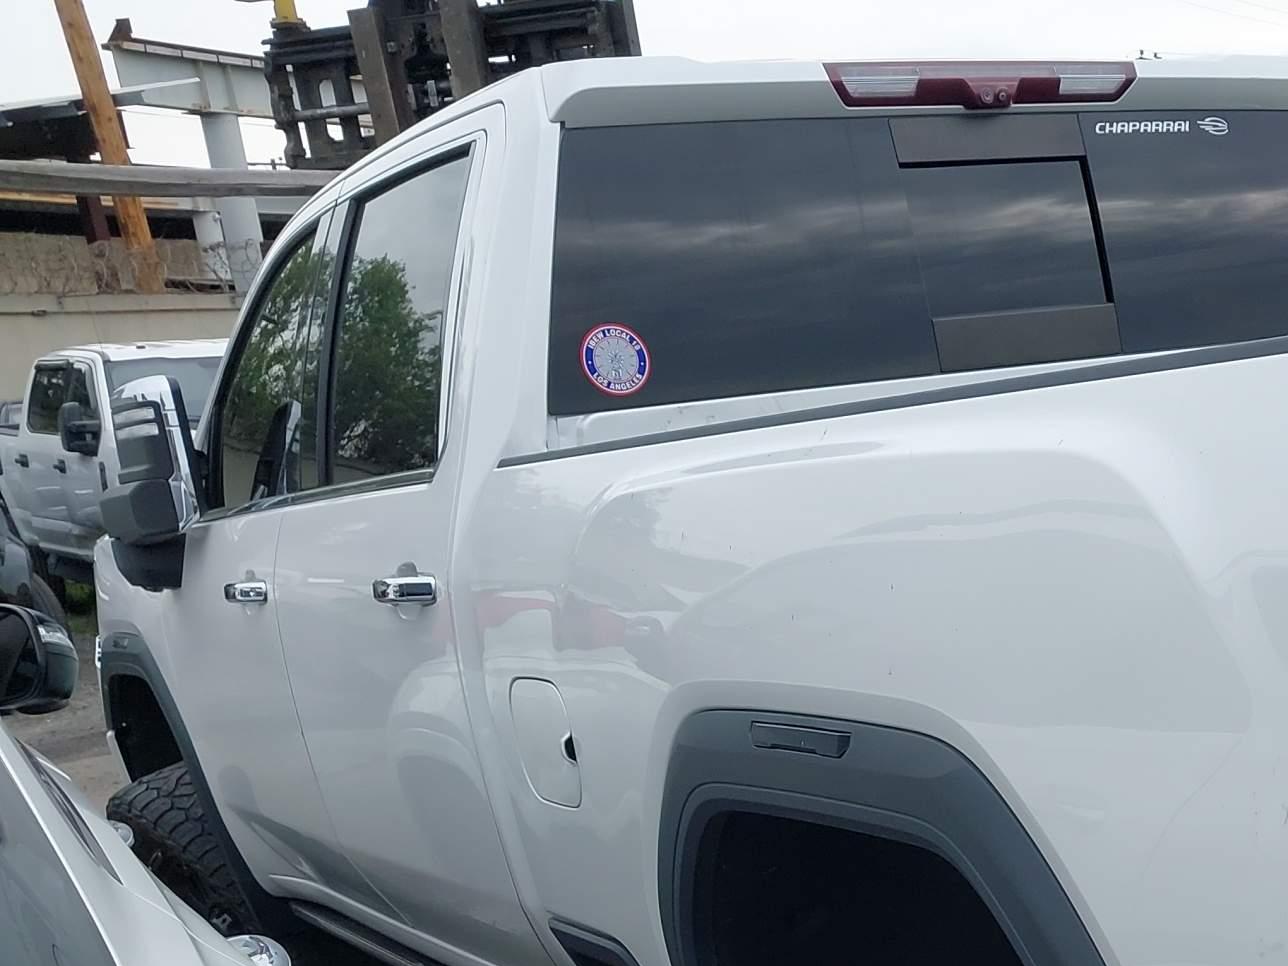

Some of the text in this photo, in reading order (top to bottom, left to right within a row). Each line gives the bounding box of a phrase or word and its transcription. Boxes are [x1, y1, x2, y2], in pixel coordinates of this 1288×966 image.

[587, 331, 605, 350] IBEW
[604, 328, 631, 342] LOCAL
[593, 371, 643, 390] LOS ANGELES
